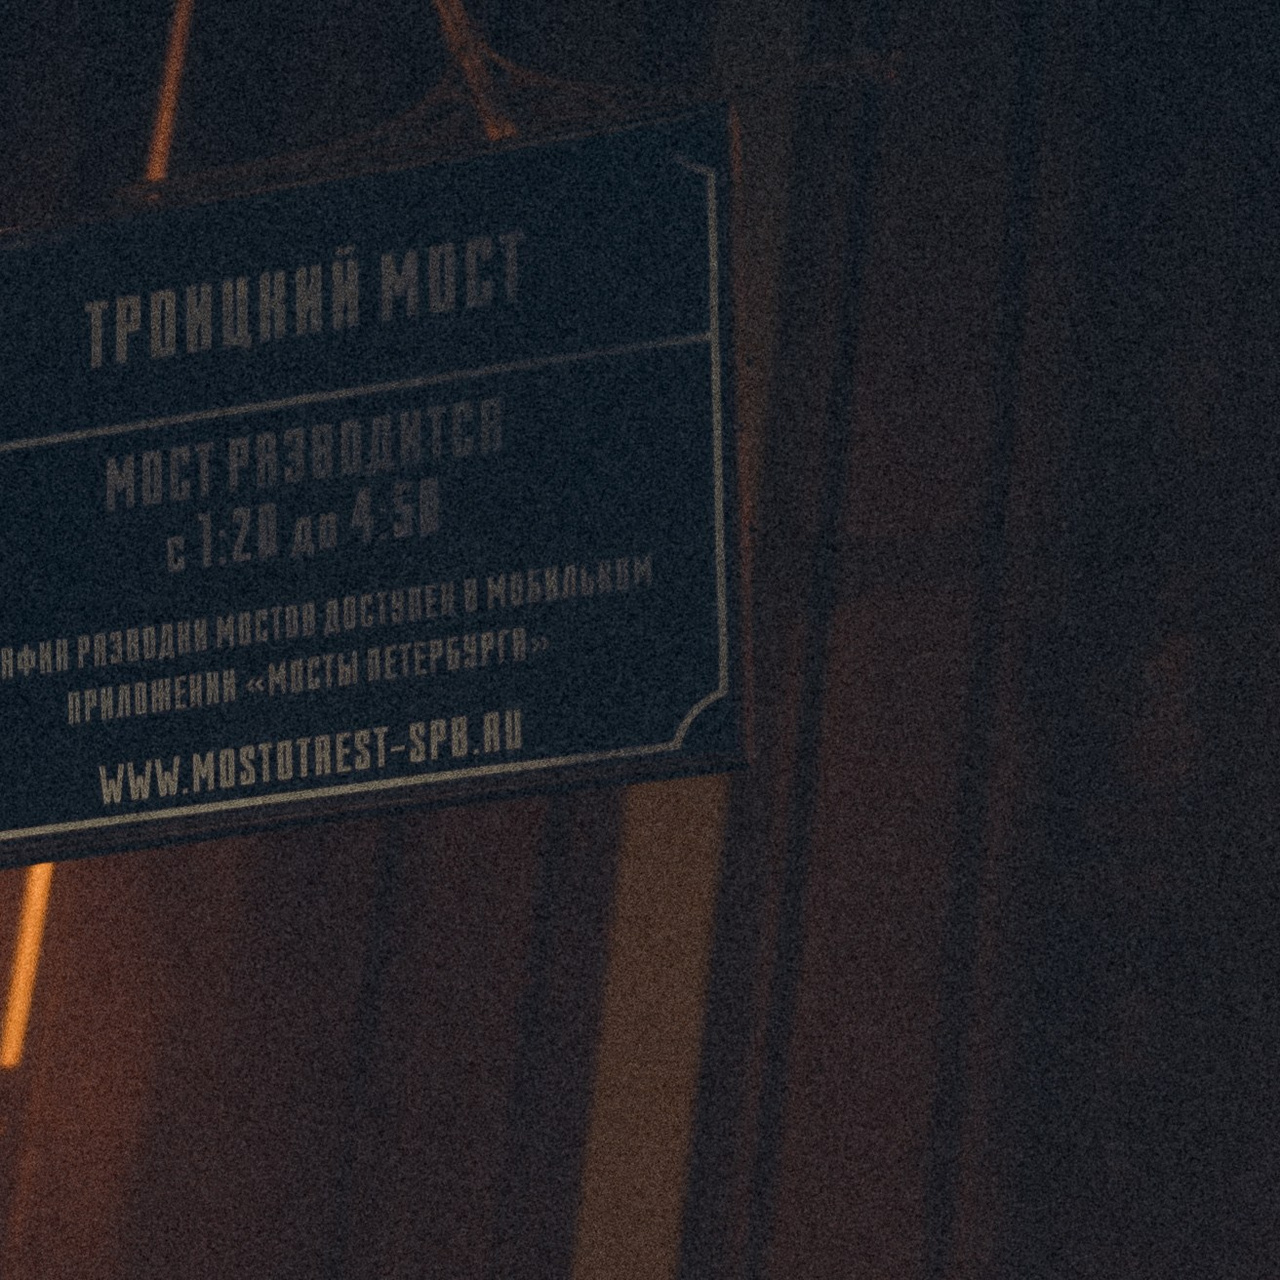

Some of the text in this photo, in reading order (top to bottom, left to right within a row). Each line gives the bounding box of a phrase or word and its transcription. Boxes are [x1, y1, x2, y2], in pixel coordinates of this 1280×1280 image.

[84, 229, 526, 369] ТРОИЦКИЙ МОСТ
[105, 397, 503, 512] МОСТ РАЗВОДИТСЯ
[197, 503, 277, 568] 1:20
[350, 478, 440, 545] 4:50
[77, 618, 207, 668] РАЗВОДКИ
[216, 601, 315, 649] МОСТОВ
[324, 581, 454, 636] ДОСТУПЕН
[487, 553, 652, 610] МОБИЛЬНОМ
[68, 669, 236, 725] ПРИЛОЖЕНИИ
[98, 708, 523, 806] WWW.MOSTOTREST-SPB.RU
